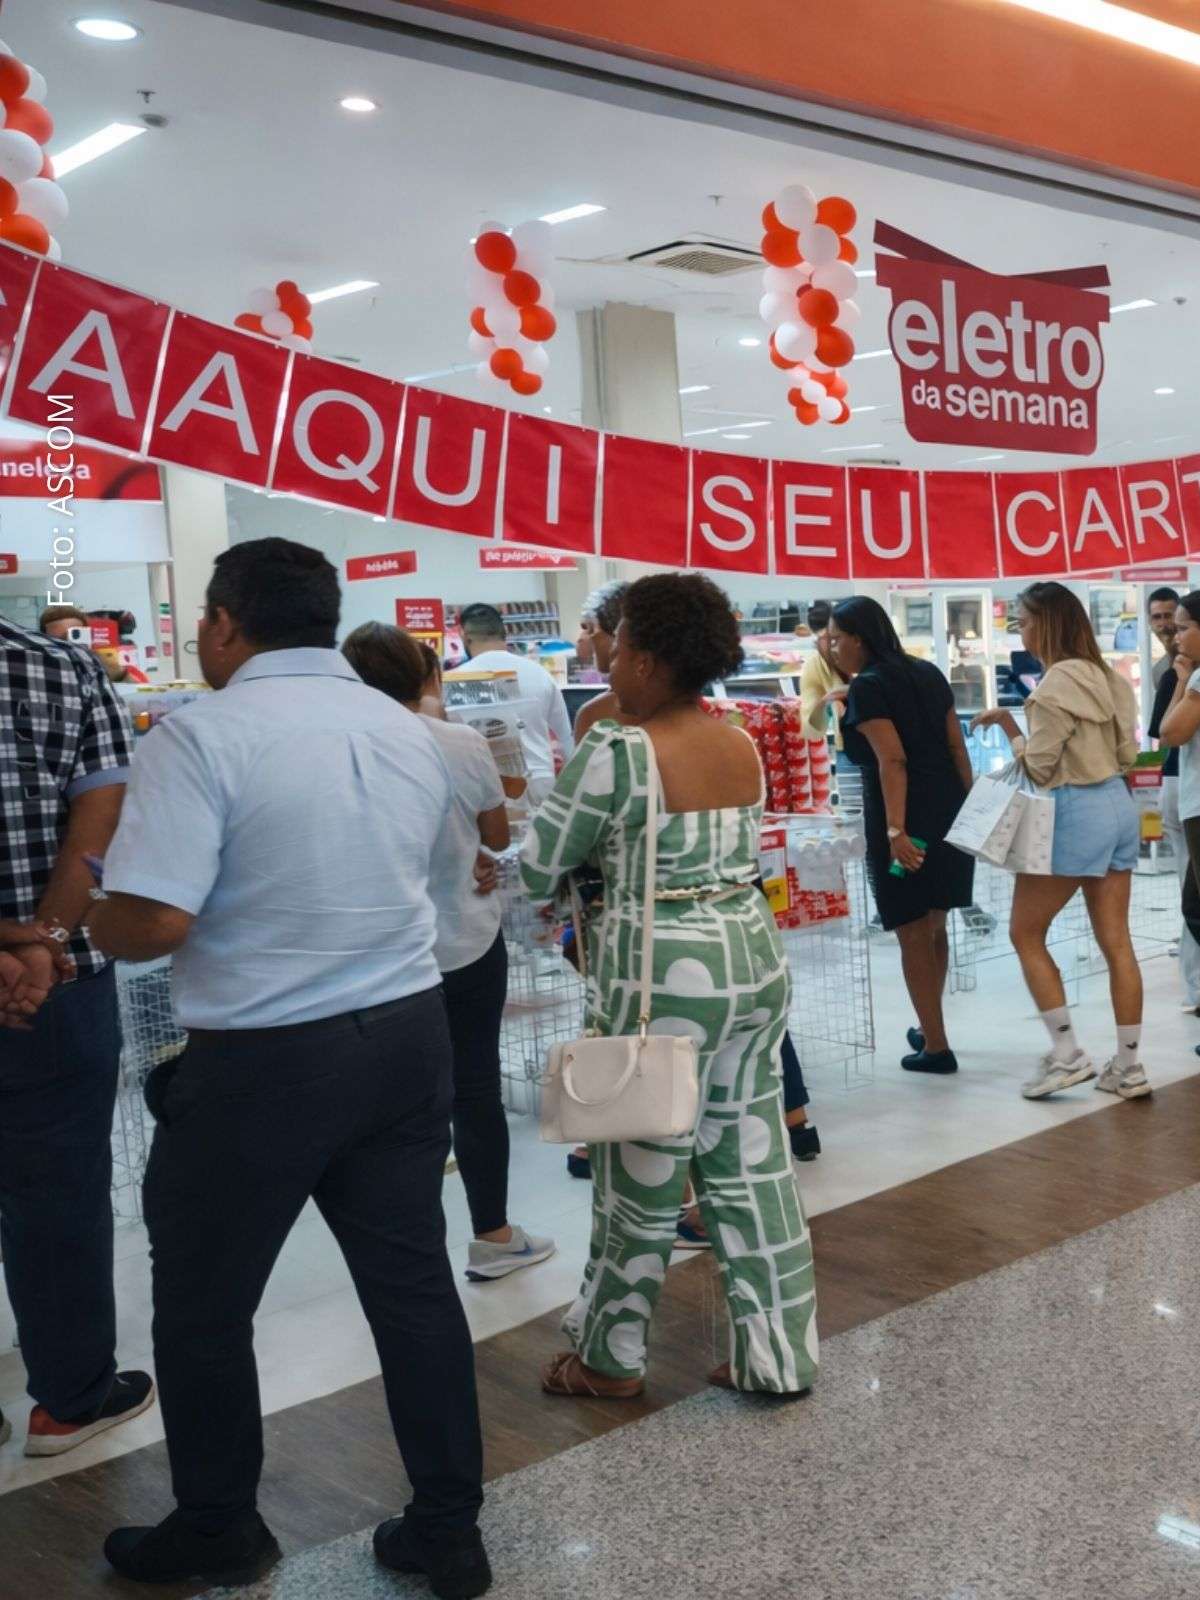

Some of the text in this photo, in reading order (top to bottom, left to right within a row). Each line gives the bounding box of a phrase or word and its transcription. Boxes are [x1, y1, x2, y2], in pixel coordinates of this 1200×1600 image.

[891, 279, 1102, 390] eletro
[911, 379, 1090, 429] da semana
[699, 475, 912, 559] SEU
